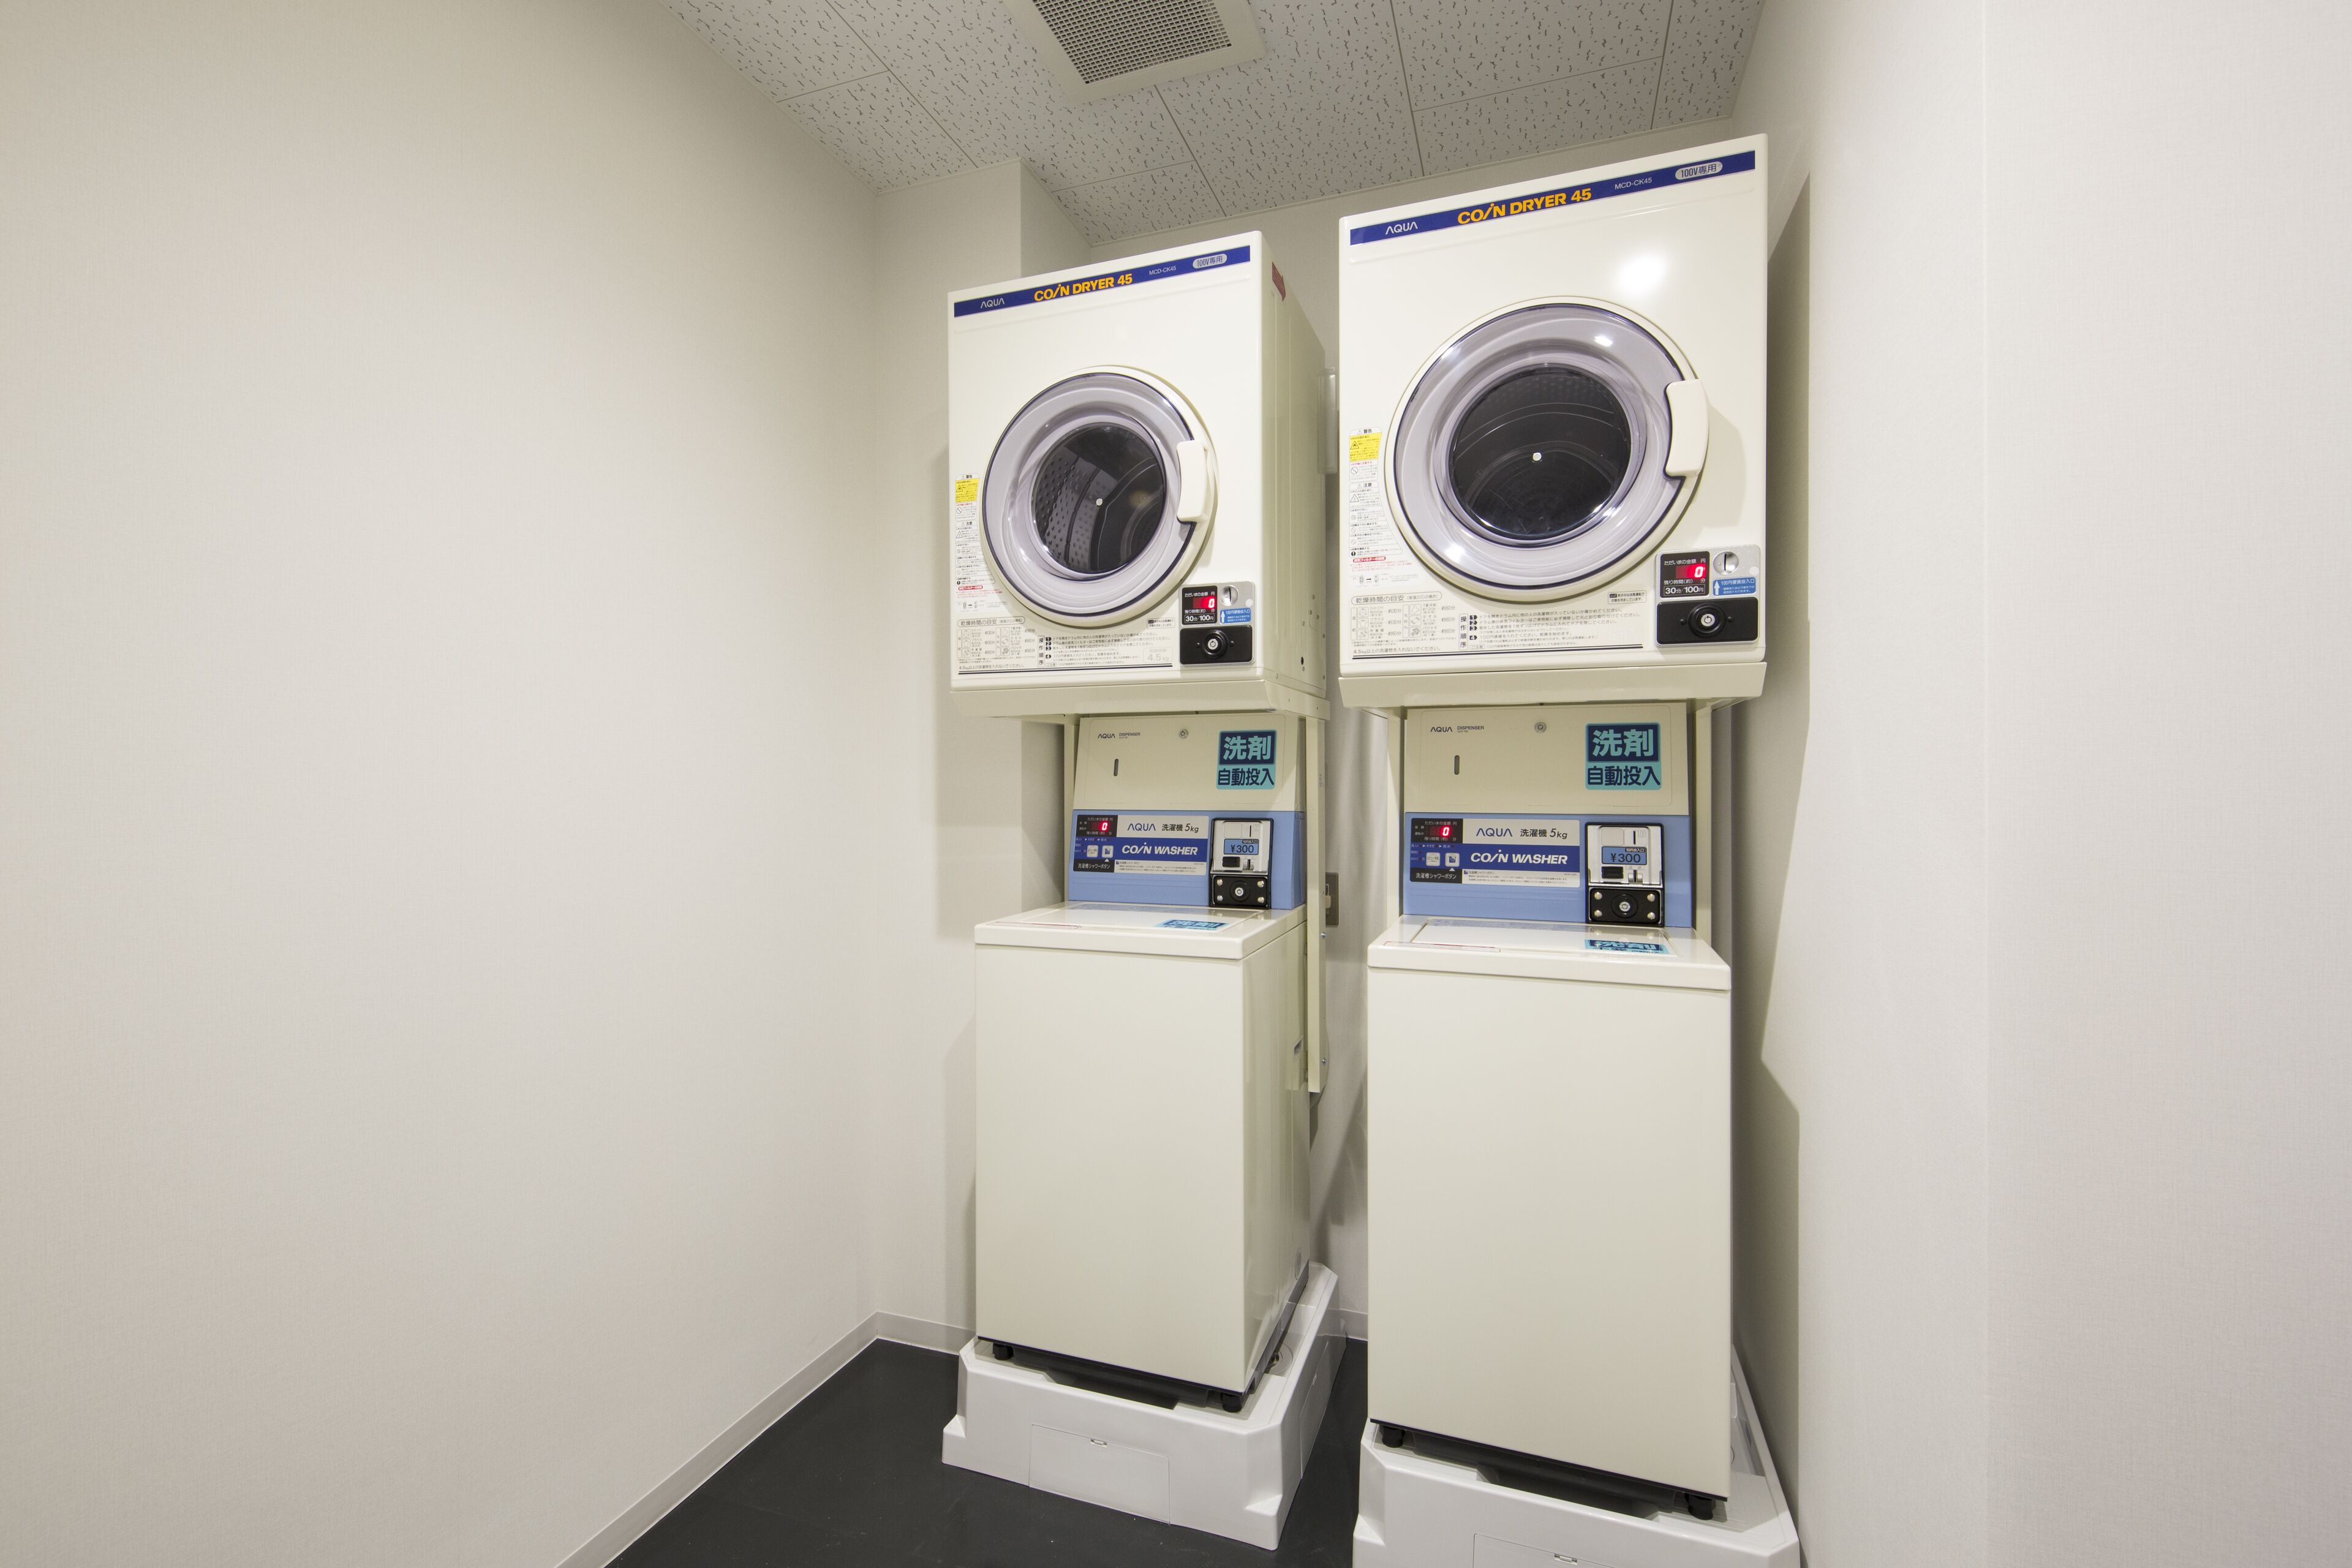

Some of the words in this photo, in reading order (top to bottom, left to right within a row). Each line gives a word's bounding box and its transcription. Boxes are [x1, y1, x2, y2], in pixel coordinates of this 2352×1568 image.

[1680, 163, 1717, 178] 100V専用
[1615, 177, 1653, 190] MCD-CK45
[1458, 202, 1506, 225] COIN
[1510, 193, 1566, 215] DRYER
[1571, 188, 1592, 202] 45
[1385, 221, 1418, 235] AQUA
[1196, 255, 1224, 268] 100V専用
[1148, 265, 1177, 276] MCD-CK45
[1034, 283, 1070, 302] COIN
[1072, 277, 1114, 295] DRYER
[1117, 273, 1133, 285] 45
[980, 297, 1005, 309] AQUA
[1694, 566, 1704, 578] 0
[1208, 598, 1215, 608] 0
[1355, 595, 1404, 604] 乾燥時間の目安
[1223, 736, 1272, 760] 洗剤
[1593, 729, 1654, 758] 洗剤
[1218, 767, 1275, 786] 自動投入
[1588, 766, 1660, 786] 自動投入
[1101, 822, 1108, 831] 0
[1162, 823, 1183, 832] 洗濯機
[1185, 823, 1199, 833] 5kg
[1442, 827, 1449, 836] 0
[1476, 828, 1513, 837] AQUA
[1520, 828, 1547, 838] 洗濯機
[1550, 828, 1567, 839] 5kg
[1121, 842, 1152, 854] COIN
[1155, 846, 1198, 855] WASHER
[1231, 844, 1254, 853] ¥300
[1470, 850, 1509, 862] COIN
[1512, 853, 1568, 865] WASHER
[1610, 853, 1641, 863] ¥300
